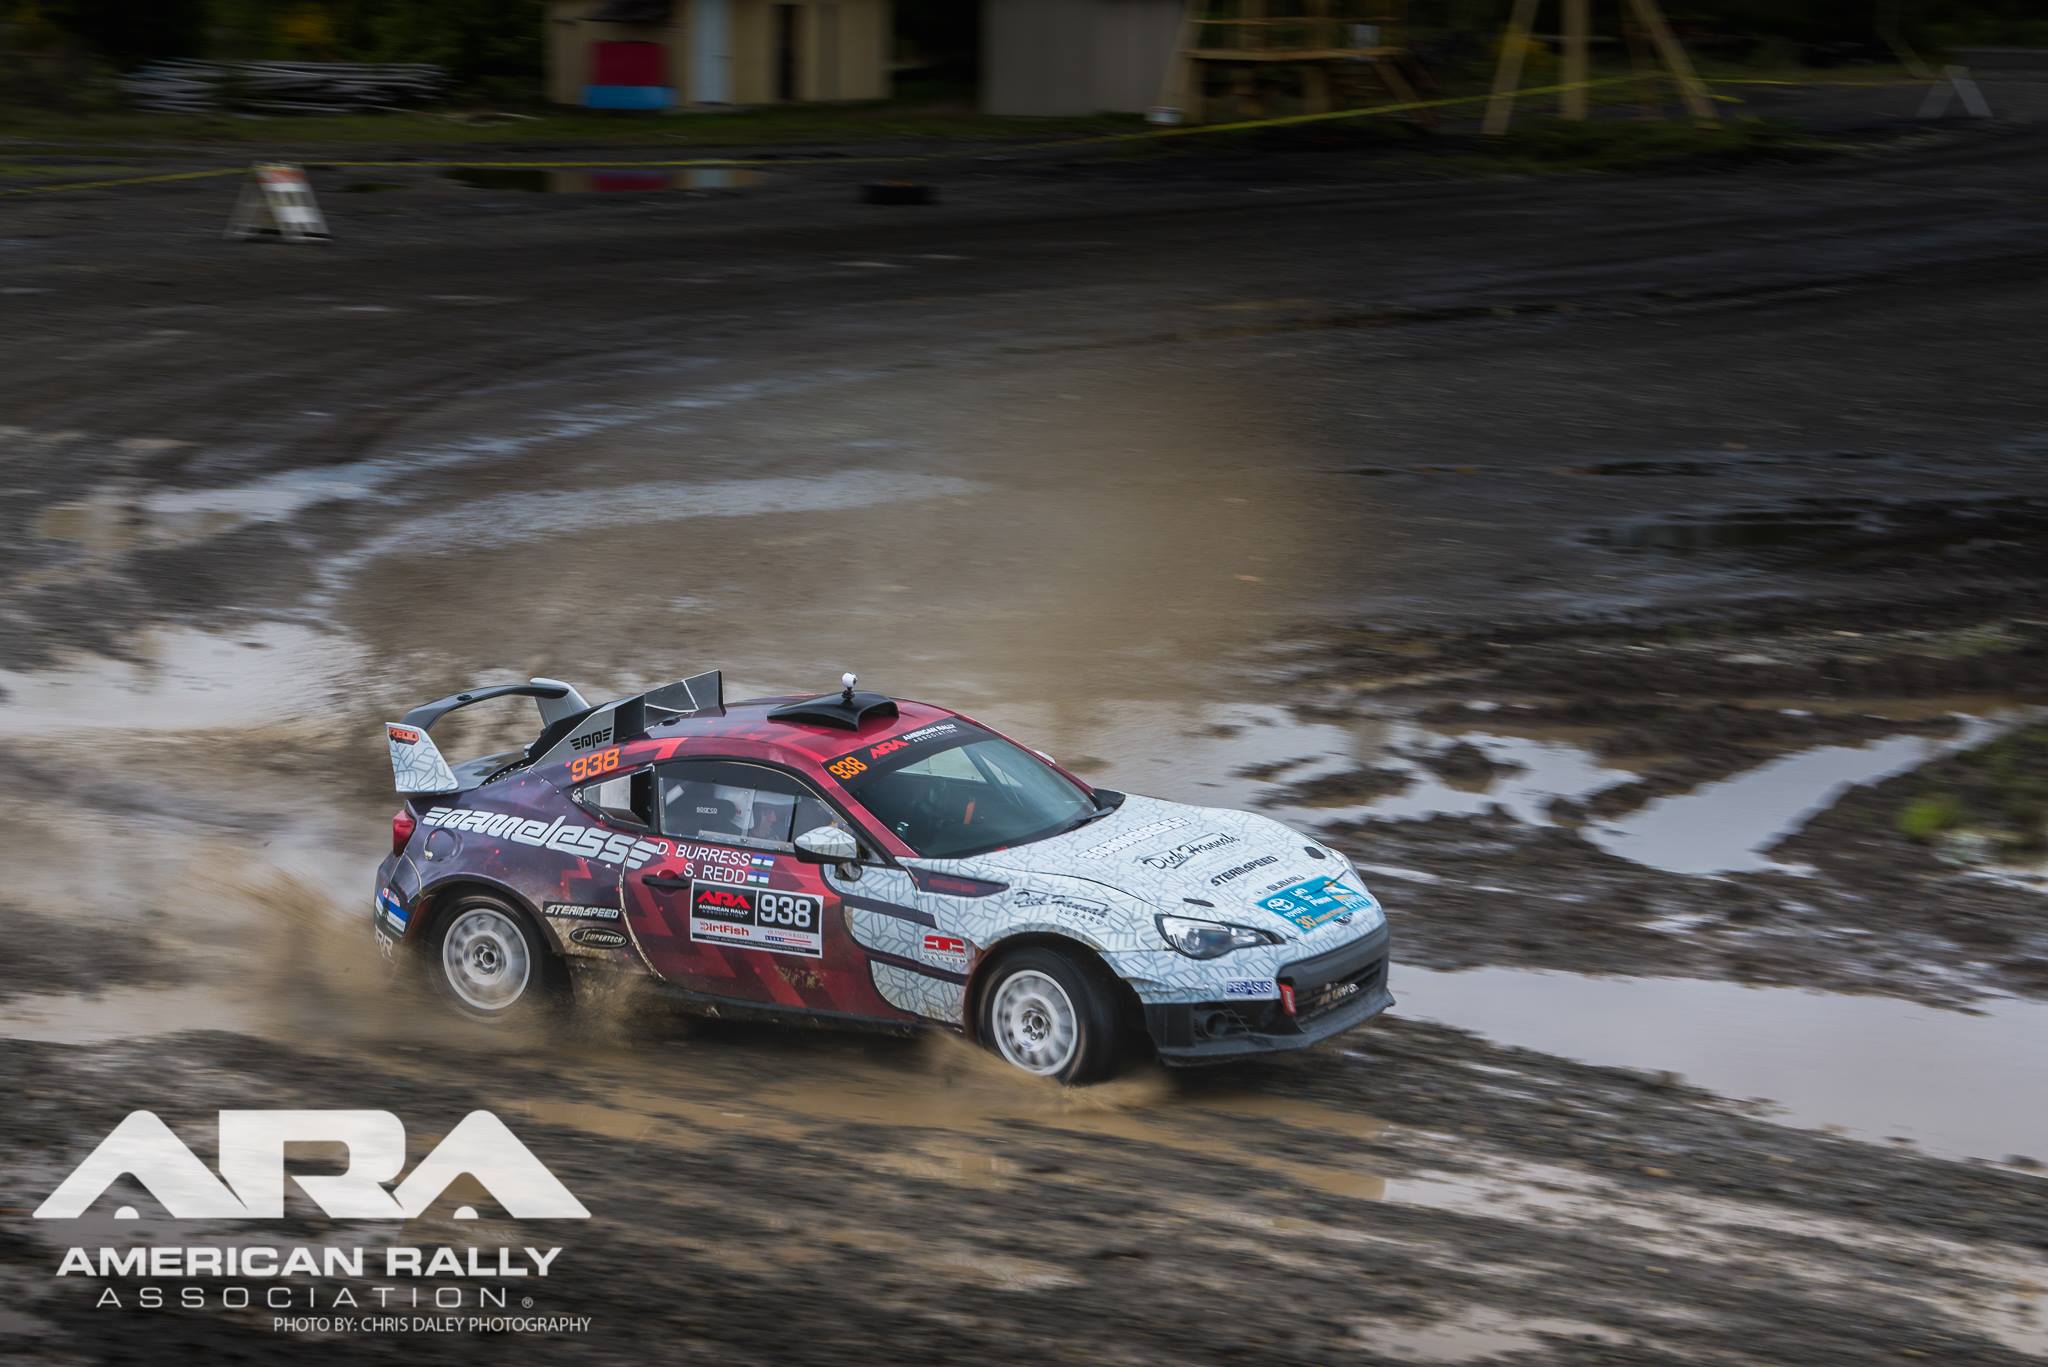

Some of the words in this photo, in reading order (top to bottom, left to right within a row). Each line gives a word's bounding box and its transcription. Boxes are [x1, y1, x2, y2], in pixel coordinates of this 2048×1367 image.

[571, 748, 620, 783] 938
[828, 756, 869, 780] 938
[656, 841, 671, 856] D.
[675, 844, 751, 868] BURRESS
[683, 862, 698, 878] S.
[702, 864, 746, 885] REDD
[1210, 855, 1279, 887] STEAMSPEED
[760, 894, 812, 928] 938
[699, 920, 750, 937] DirtFish
[1225, 979, 1274, 996] PEGASUS
